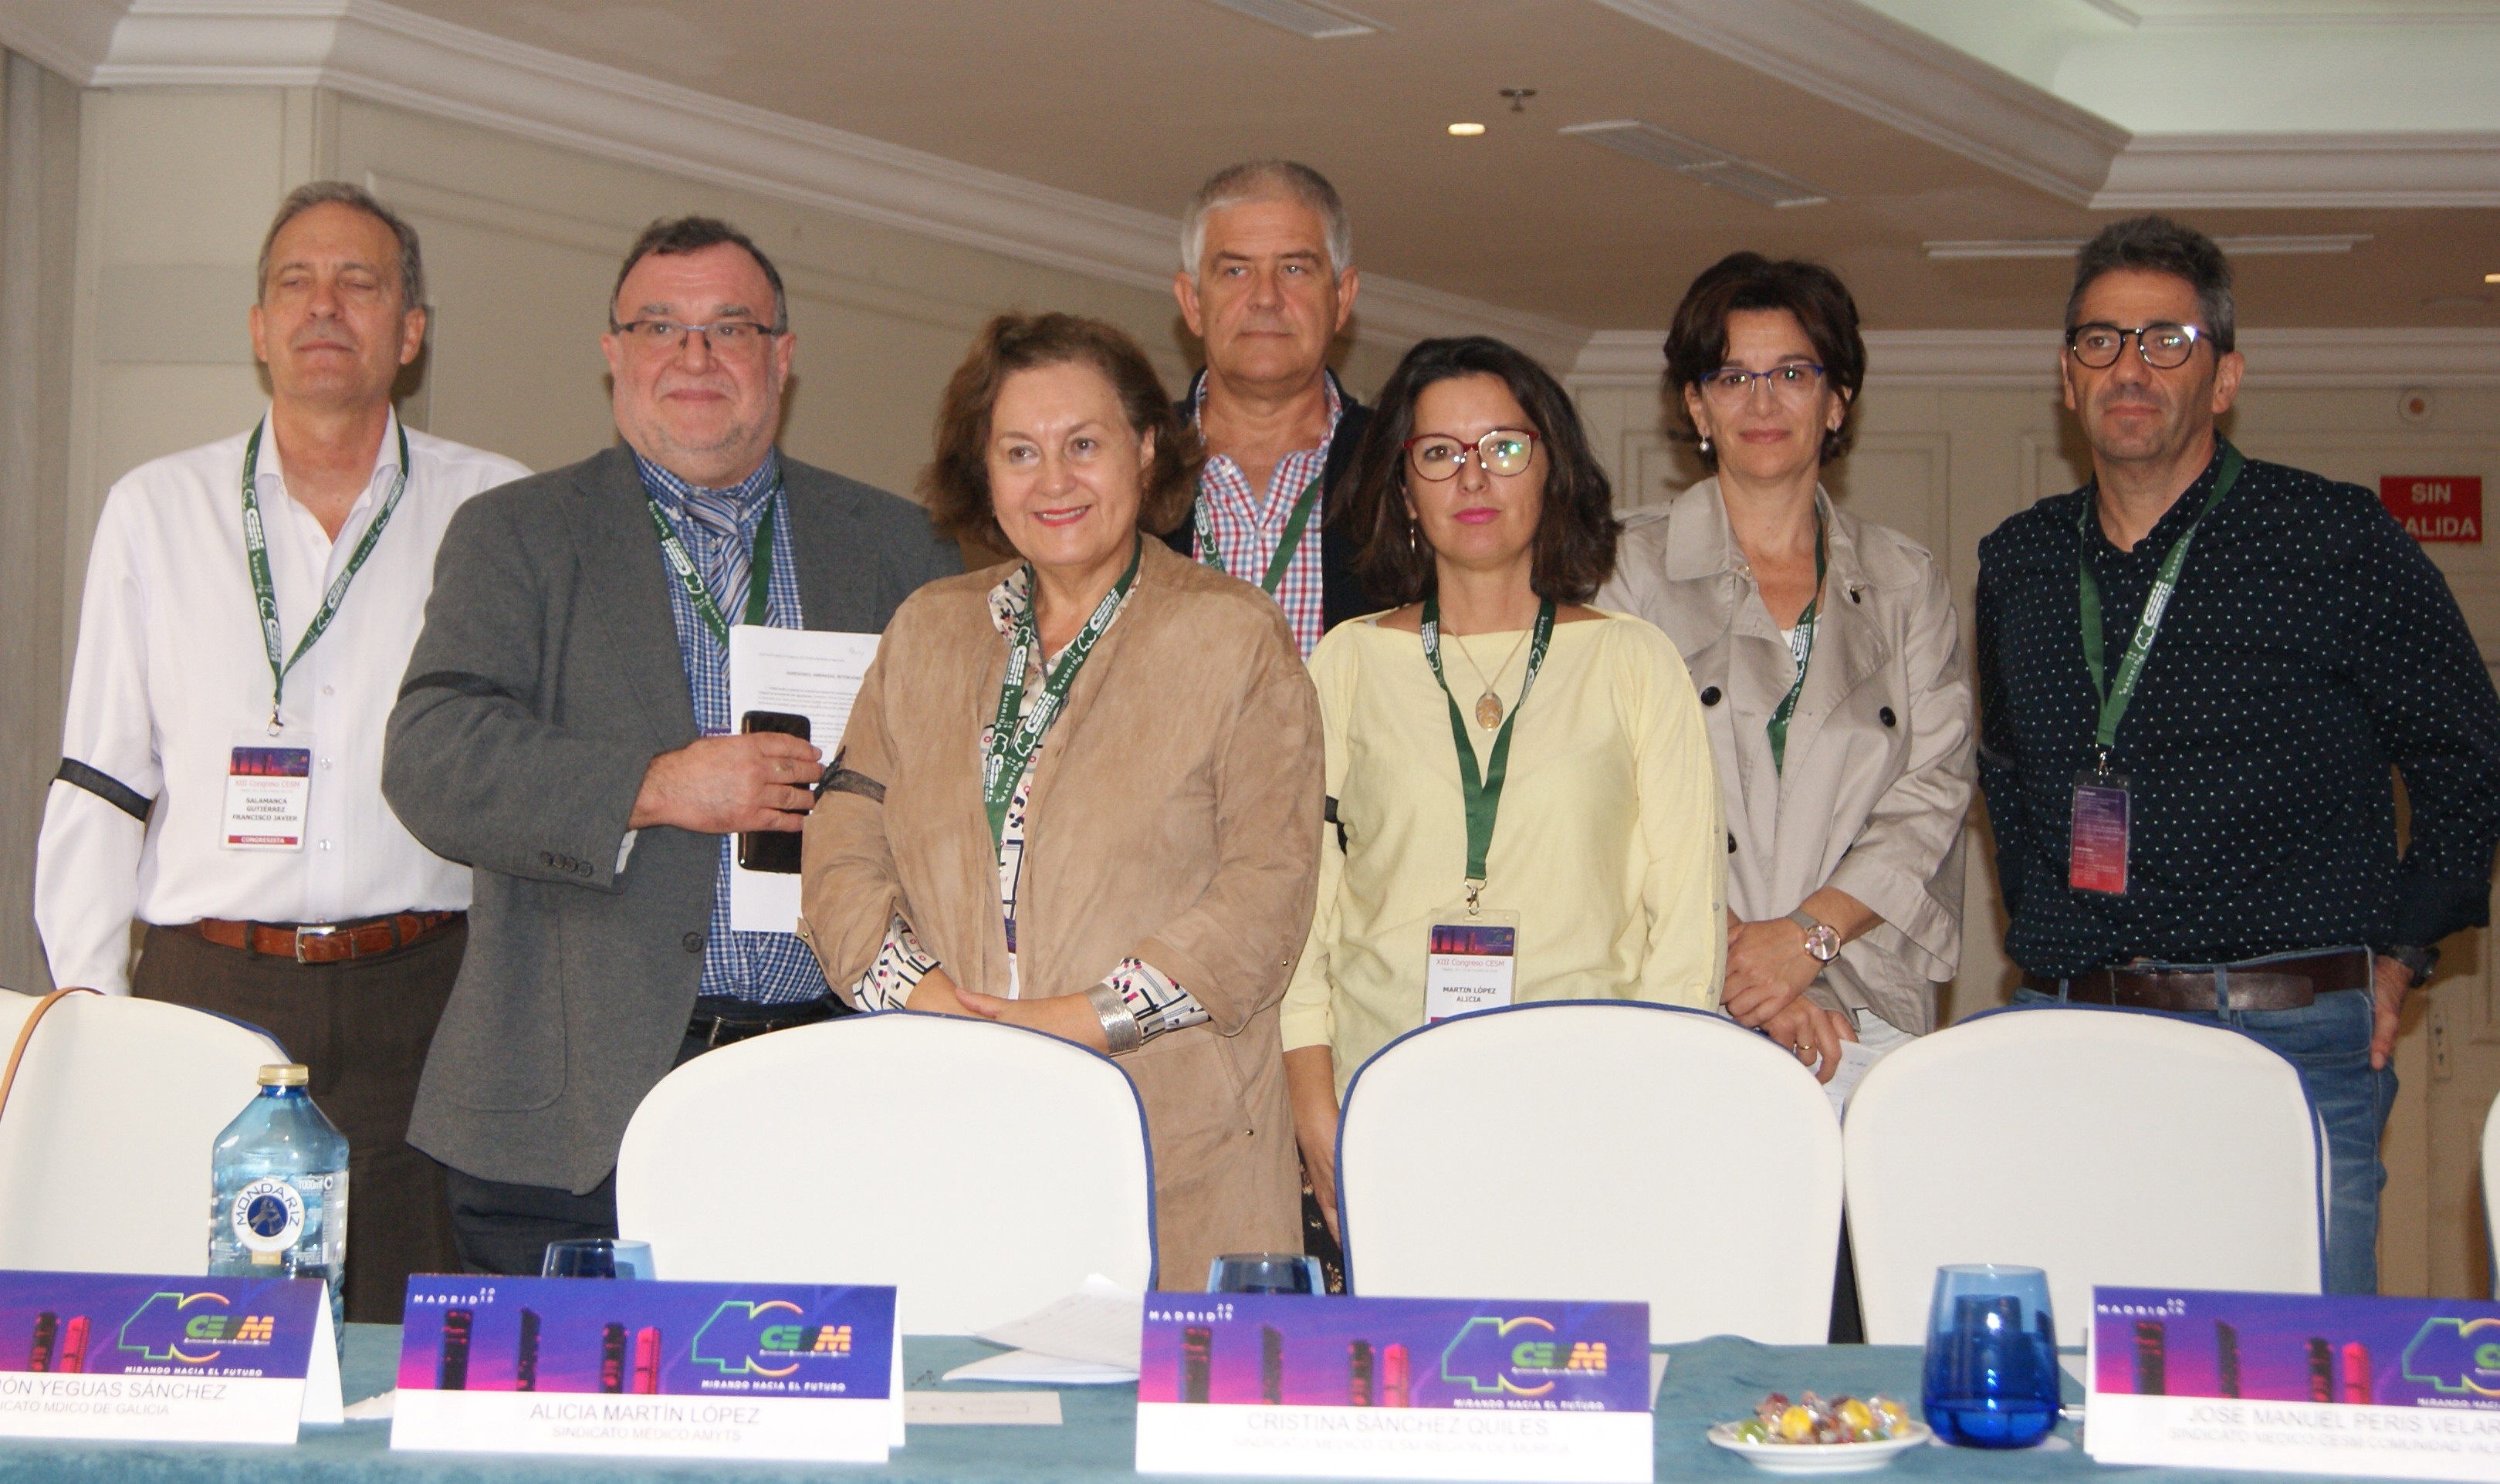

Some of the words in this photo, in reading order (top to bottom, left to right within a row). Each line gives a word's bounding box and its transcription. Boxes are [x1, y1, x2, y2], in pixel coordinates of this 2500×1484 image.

[2411, 482, 2451, 504] SIN
[2393, 516, 2477, 537] ALIDA
[1452, 959, 1483, 968] Congreso
[236, 1182, 300, 1227] MONDARIZ
[414, 1293, 478, 1305] MADRID
[1149, 1310, 1216, 1322] MADRID
[2097, 1304, 2167, 1317] MADRID
[124, 1365, 171, 1375] MIRANDO
[174, 1367, 205, 1376] HACIA
[223, 1368, 264, 1378] FUTURO
[0, 1376, 32, 1396] ÓN
[39, 1380, 123, 1398] YEGUAS
[129, 1378, 227, 1400] SÁNCHEZ
[701, 1379, 750, 1390] MIRANDO
[753, 1381, 785, 1391] HACIA
[787, 1381, 801, 1391] EL
[804, 1382, 847, 1393] FUTURO
[44, 1401, 90, 1414] MDICO
[93, 1402, 112, 1414] DE
[116, 1402, 170, 1415] GALICIA
[1453, 1398, 1505, 1409] MIRANDO
[1507, 1399, 1541, 1410] HACIA
[529, 1402, 598, 1420] ALICIA
[604, 1402, 683, 1423] MARTÍN
[690, 1403, 760, 1425] LÓPEZ
[2253, 1408, 2344, 1429] MANUEL
[2353, 1411, 2421, 1433] PERIS
[1247, 1412, 1350, 1434] CRISTINA
[1355, 1411, 1461, 1436] SÁNCHEZ
[1468, 1416, 1550, 1438] QUILES
[552, 1425, 628, 1439] SINDICATO
[692, 1428, 742, 1442] AMYTS
